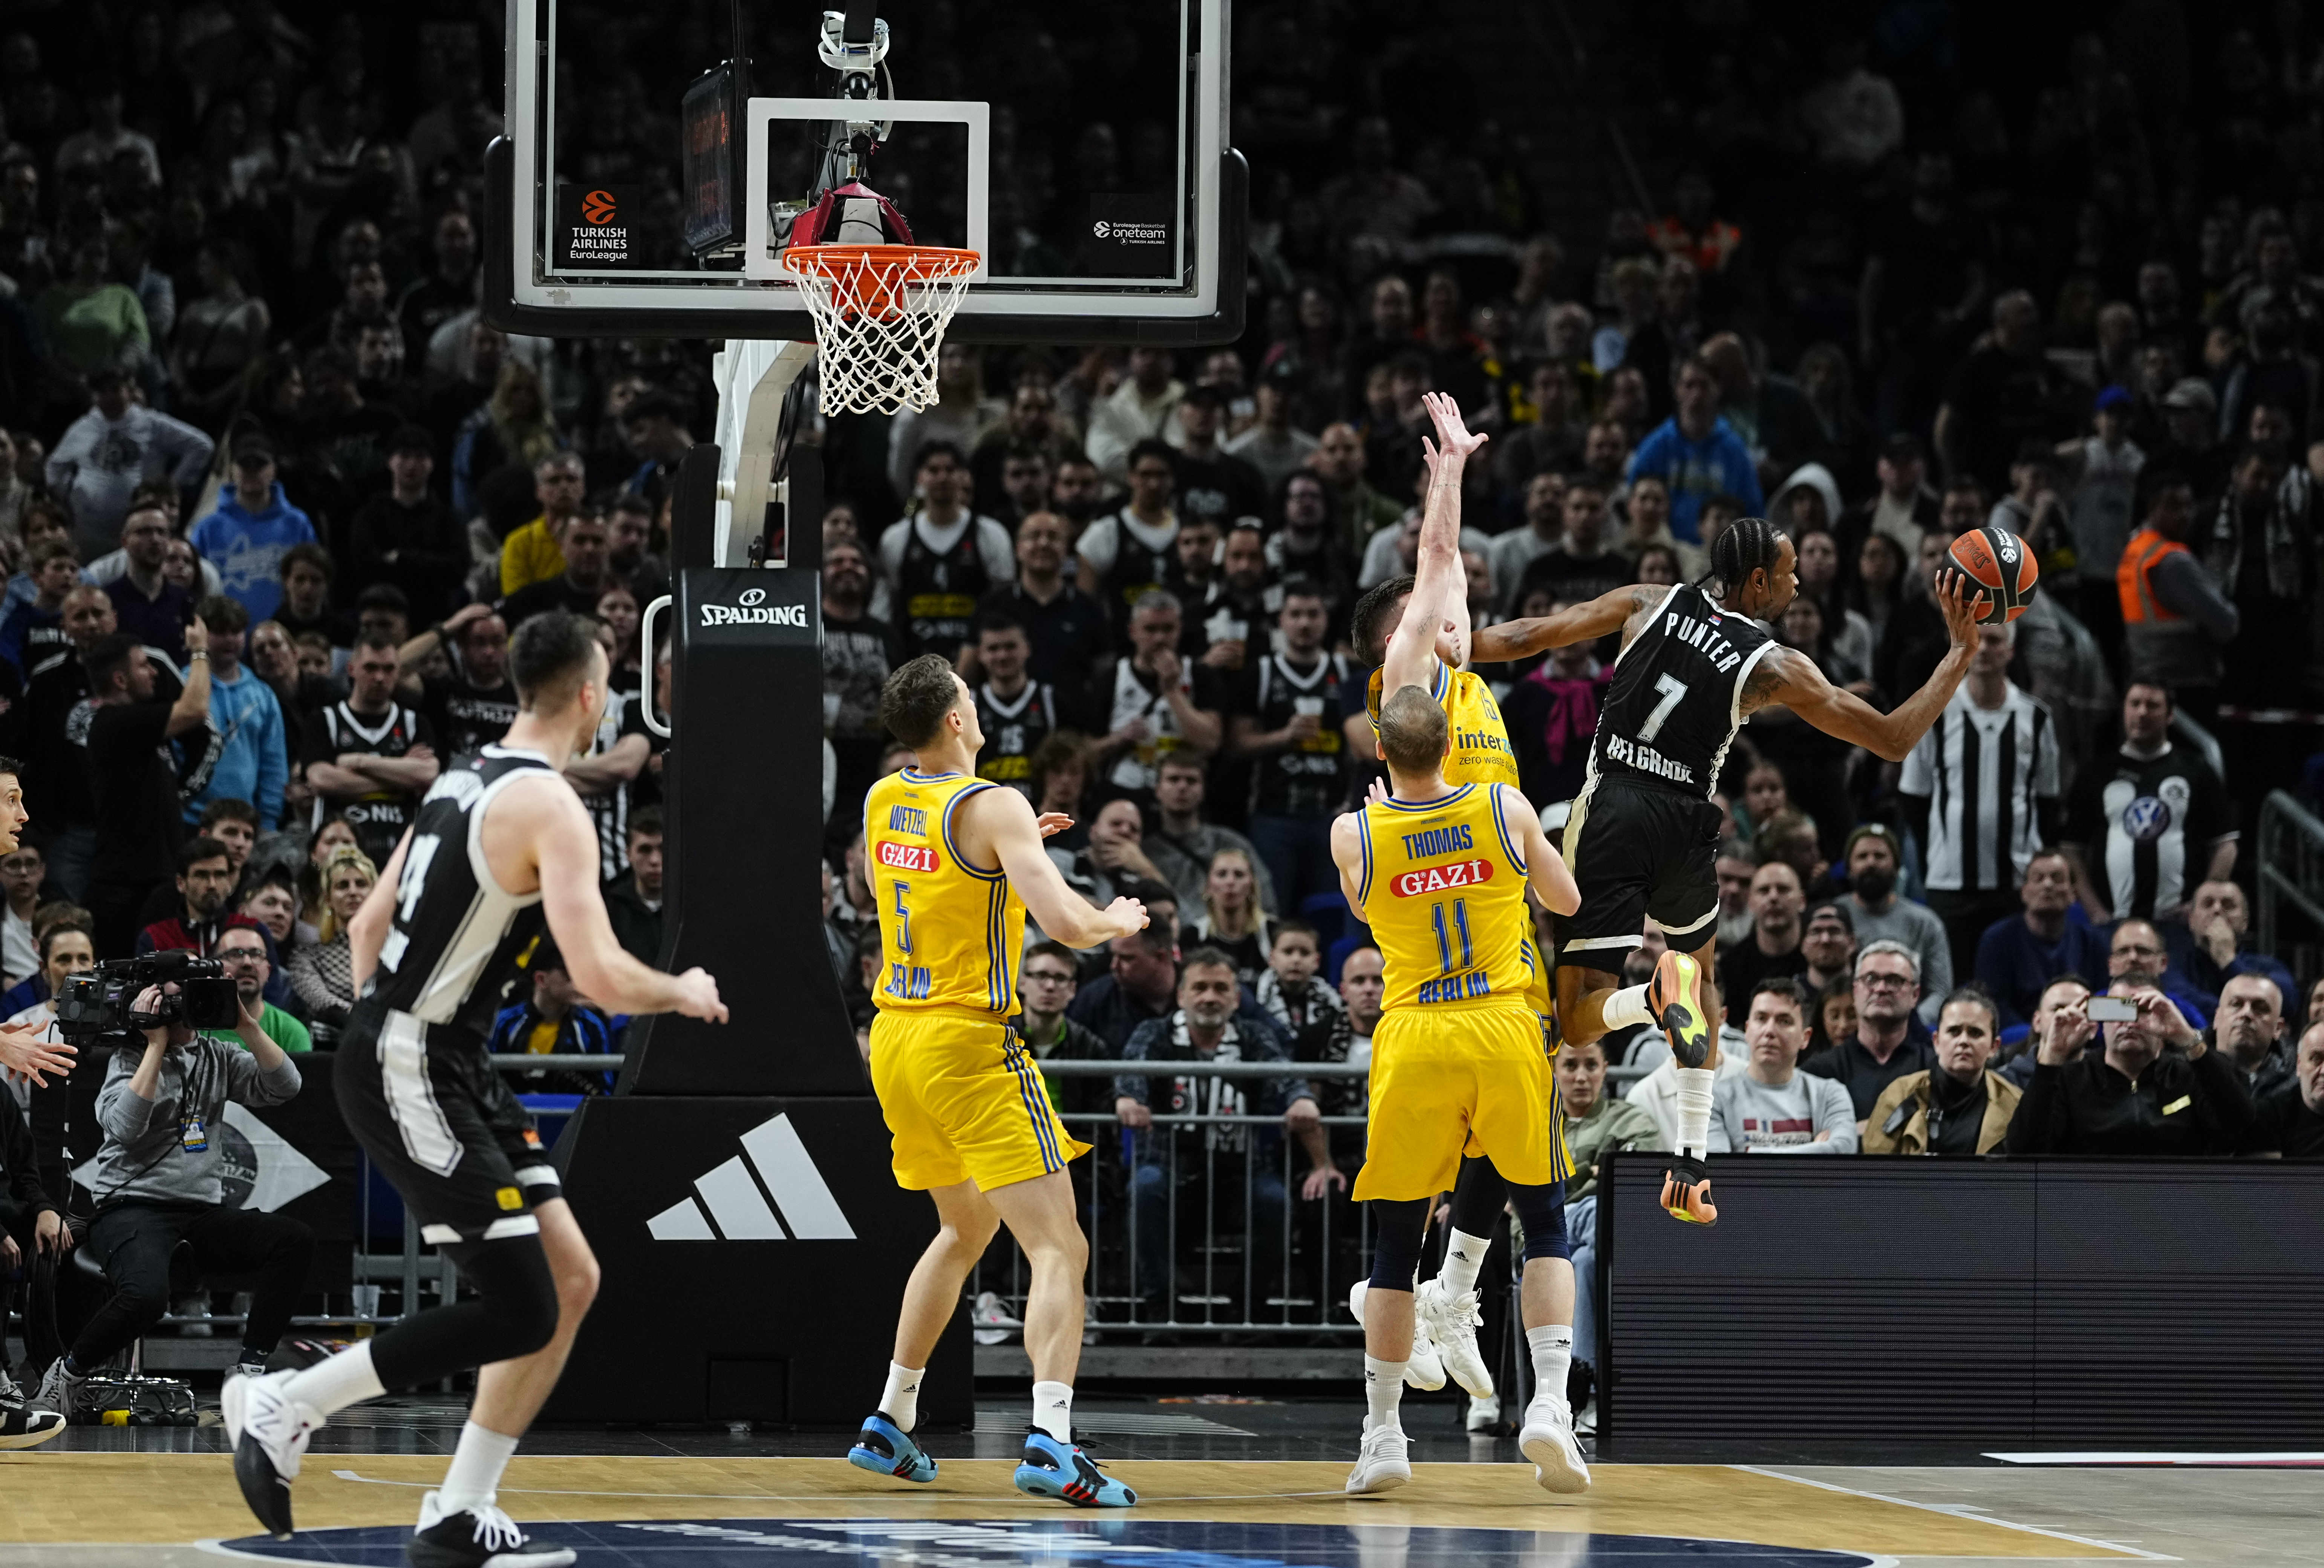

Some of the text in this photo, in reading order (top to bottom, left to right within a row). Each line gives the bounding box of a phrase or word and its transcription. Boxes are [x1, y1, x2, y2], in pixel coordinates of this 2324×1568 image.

[571, 239, 627, 249] AIRLINES
[572, 228, 626, 237] TURKISH
[1113, 228, 1165, 238] oneteam
[570, 250, 628, 262] EuroLeague
[701, 604, 807, 627] SPALDING
[1664, 612, 1741, 673] PUNTER
[1637, 672, 1688, 743] 7
[1484, 757, 1505, 767] waste
[889, 804, 928, 837] WETZELL
[1402, 824, 1473, 860] THOMAS
[893, 879, 914, 956] 5
[1432, 898, 1473, 974] 11
[1451, 1253, 1468, 1262] adidas
